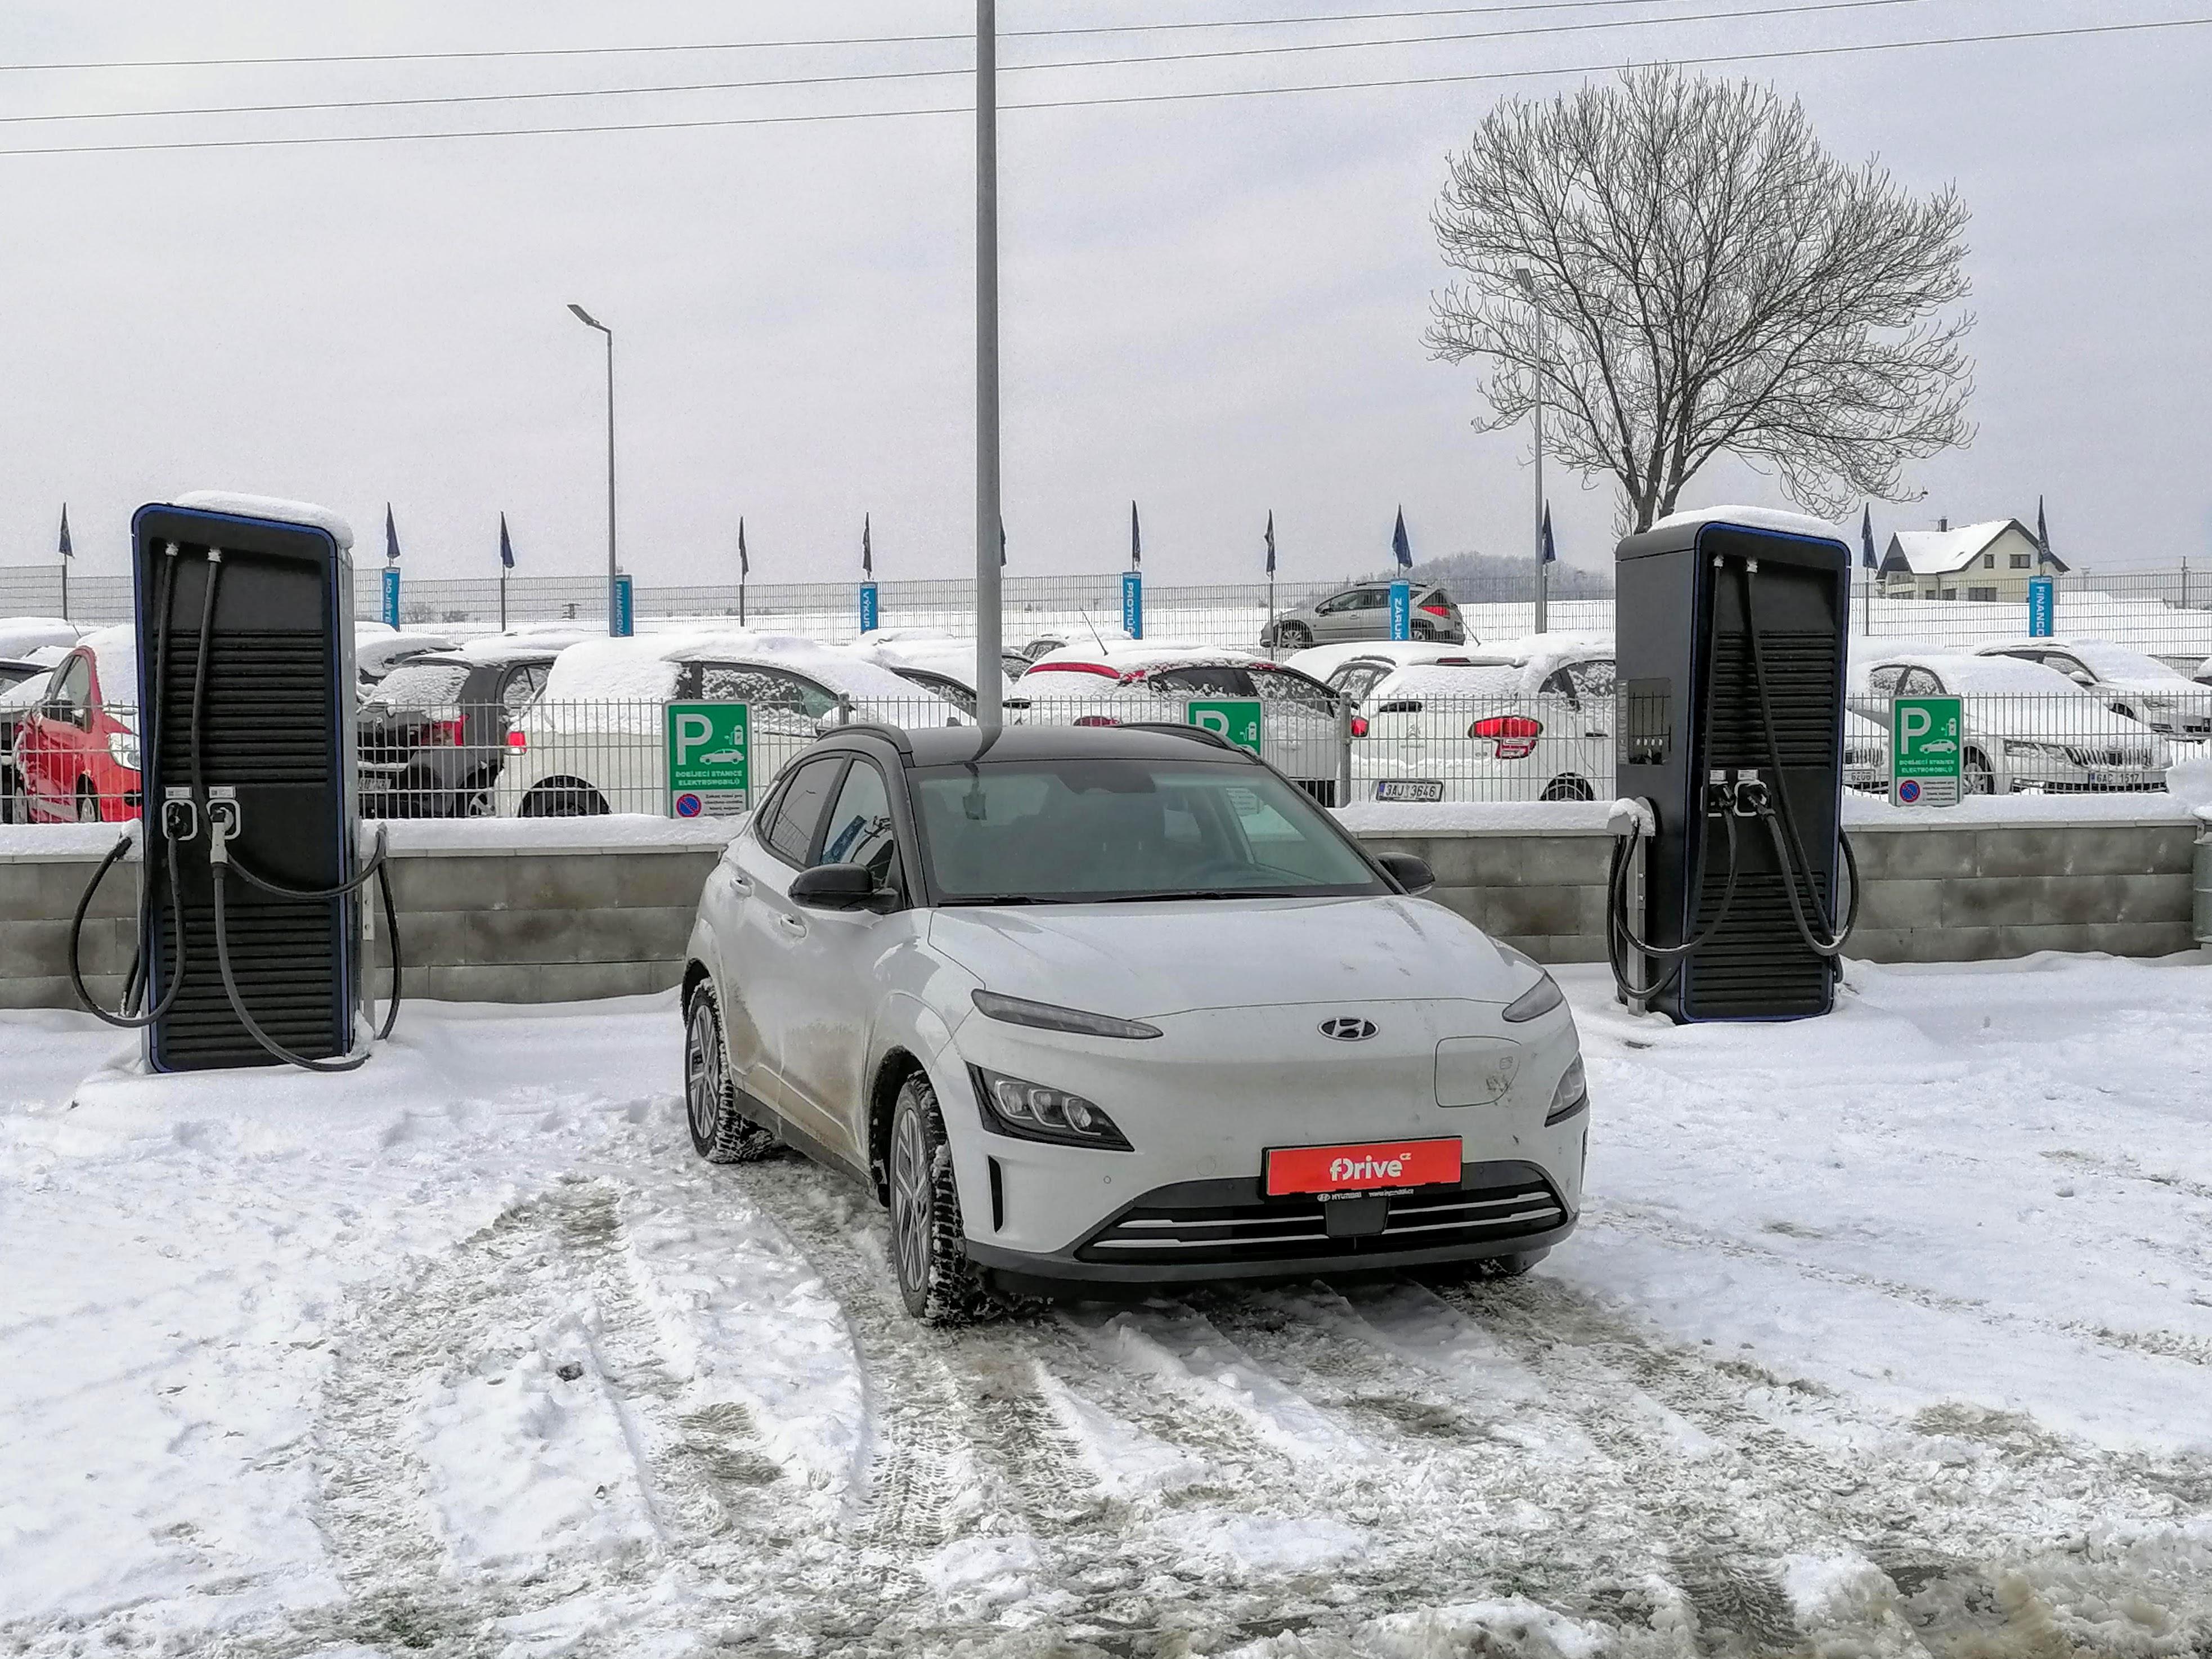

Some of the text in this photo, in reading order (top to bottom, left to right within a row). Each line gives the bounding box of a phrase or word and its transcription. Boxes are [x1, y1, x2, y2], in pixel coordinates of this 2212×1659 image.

[676, 713, 713, 765] P
[1901, 707, 1931, 754] P
[1386, 784, 1405, 796] 3AJ
